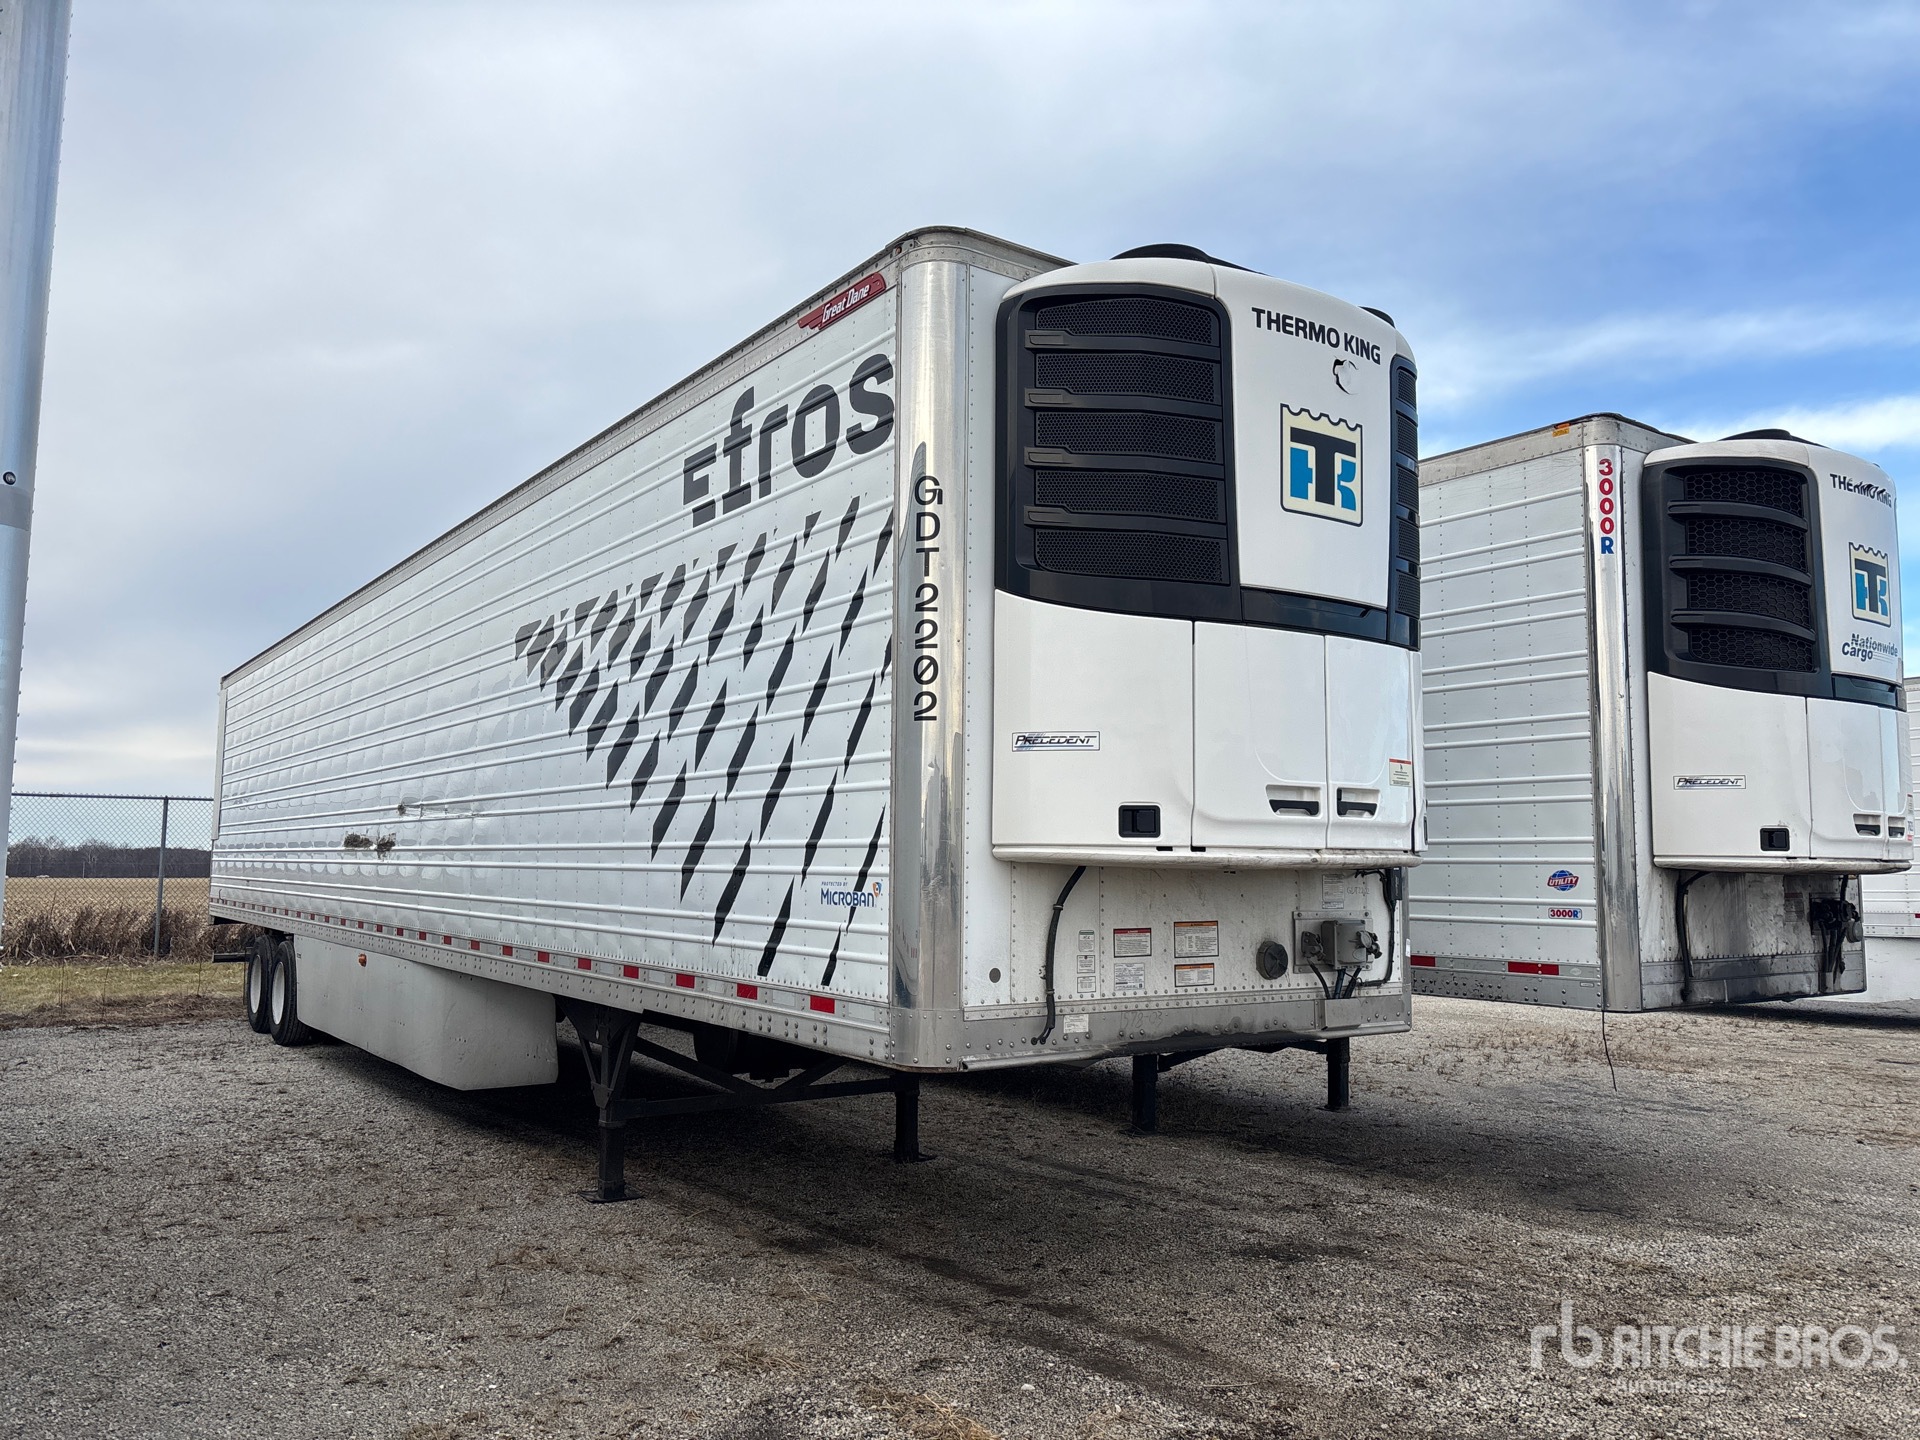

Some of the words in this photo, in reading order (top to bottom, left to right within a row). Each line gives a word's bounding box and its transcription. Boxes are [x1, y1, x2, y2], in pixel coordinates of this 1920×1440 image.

[822, 299, 846, 322] Great
[846, 285, 870, 308] Dane
[1251, 306, 1340, 349] THERMO
[1343, 332, 1381, 366] KING
[1599, 458, 1615, 555] 3000R
[913, 475, 943, 722] GDT2202
[1842, 642, 1873, 662] Cargo
[1851, 633, 1899, 658] Nationwide
[1549, 877, 1578, 886] UTILITY
[1550, 909, 1579, 918] 3000R
